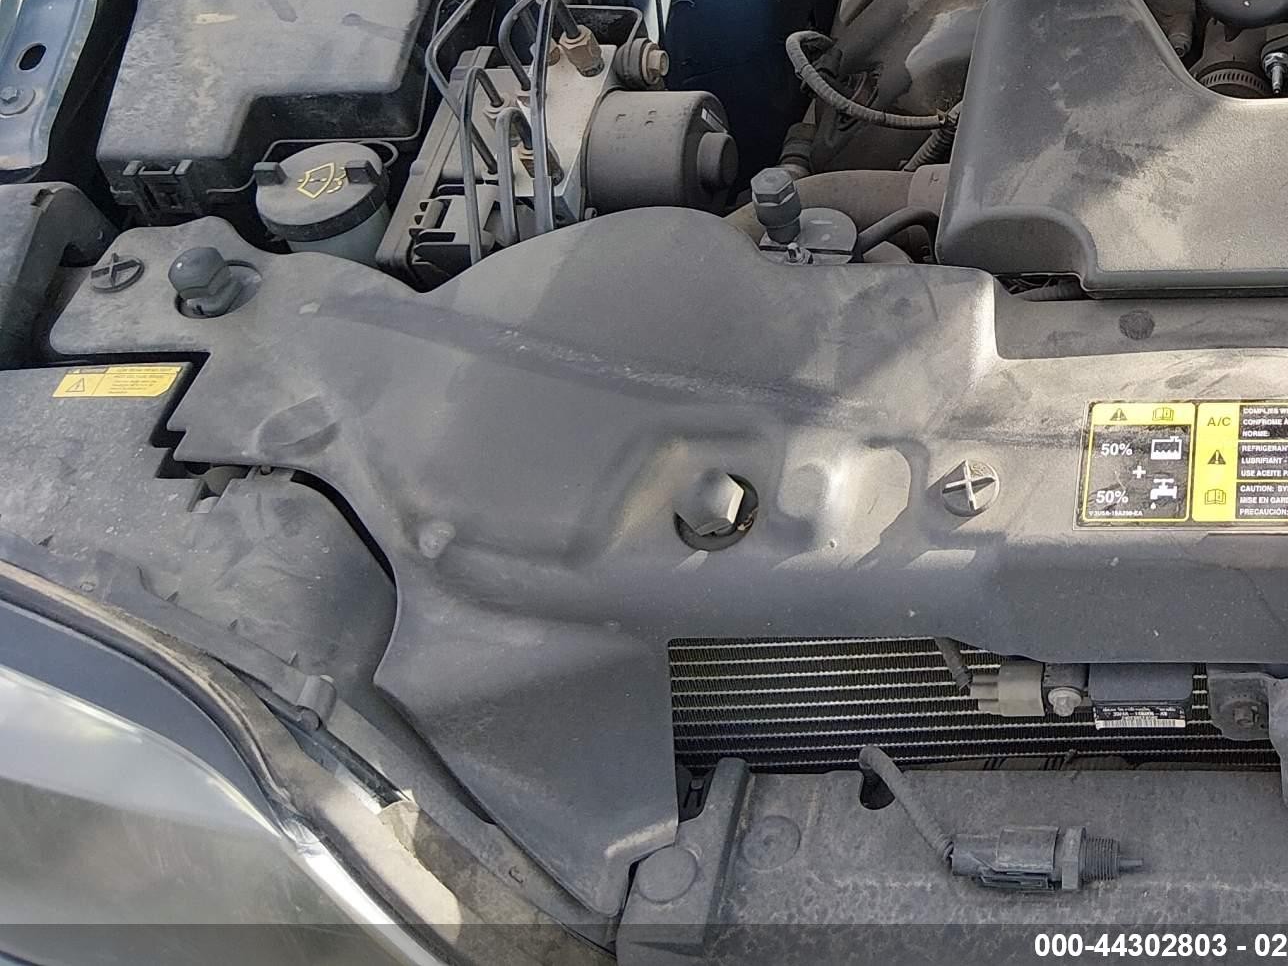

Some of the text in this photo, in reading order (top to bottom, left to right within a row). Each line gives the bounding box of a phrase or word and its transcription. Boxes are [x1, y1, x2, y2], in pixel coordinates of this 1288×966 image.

[1206, 417, 1232, 427] A/C
[1100, 443, 1133, 456] 50%
[1095, 490, 1129, 503] 50%
